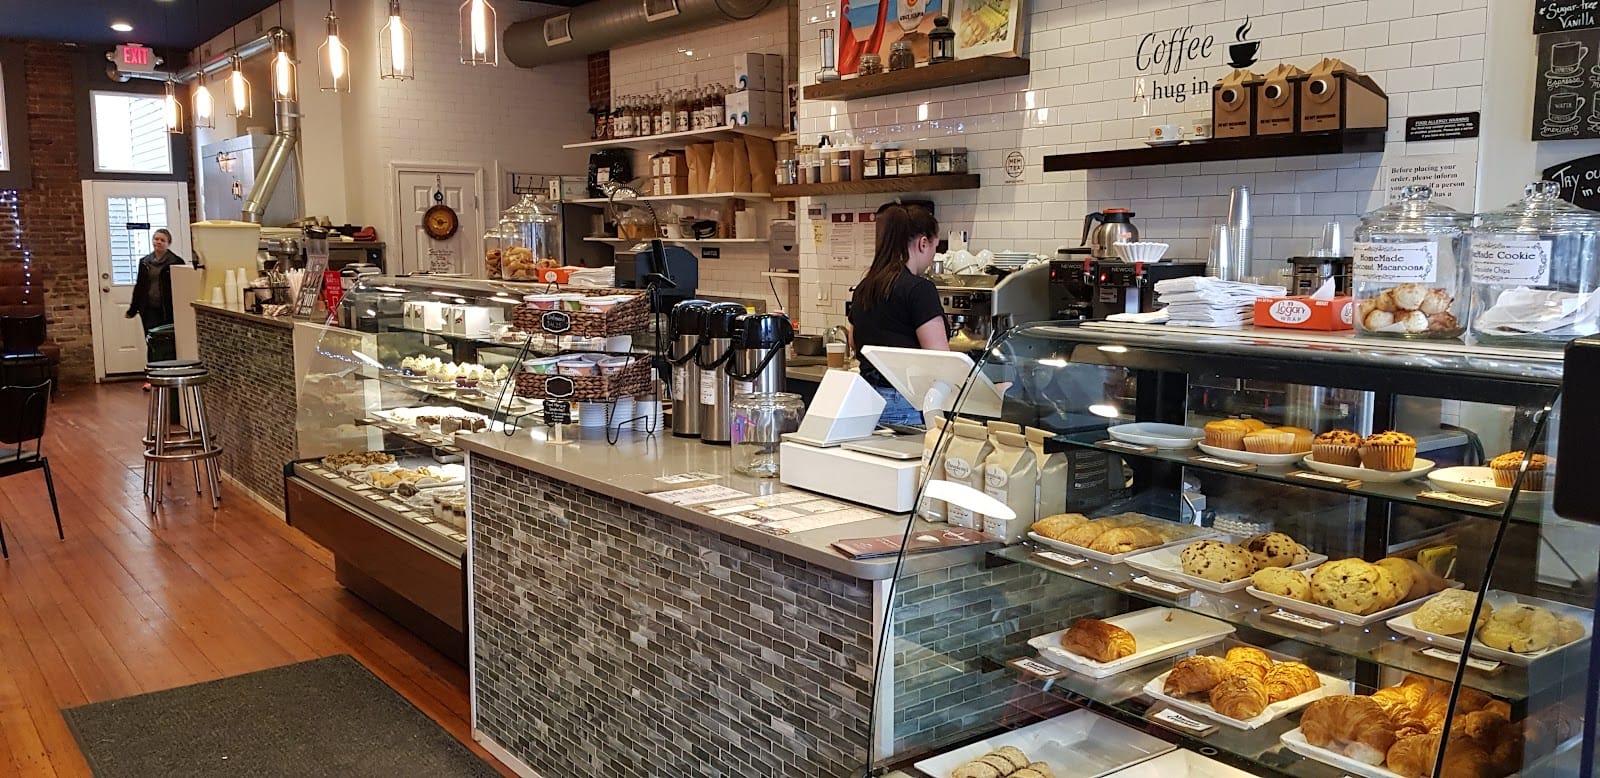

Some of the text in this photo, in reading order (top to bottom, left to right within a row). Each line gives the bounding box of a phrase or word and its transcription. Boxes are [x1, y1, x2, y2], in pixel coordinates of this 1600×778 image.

[1136, 25, 1214, 75] Coffee
[123, 47, 149, 65] EXIT
[1152, 81, 1186, 103] hug
[1192, 76, 1209, 95] in
[1391, 164, 1457, 174] Before placing your
[1412, 174, 1433, 182] please
[1441, 181, 1465, 189] person
[1496, 251, 1536, 260] Cookie
[1376, 263, 1424, 271] Macaroons
